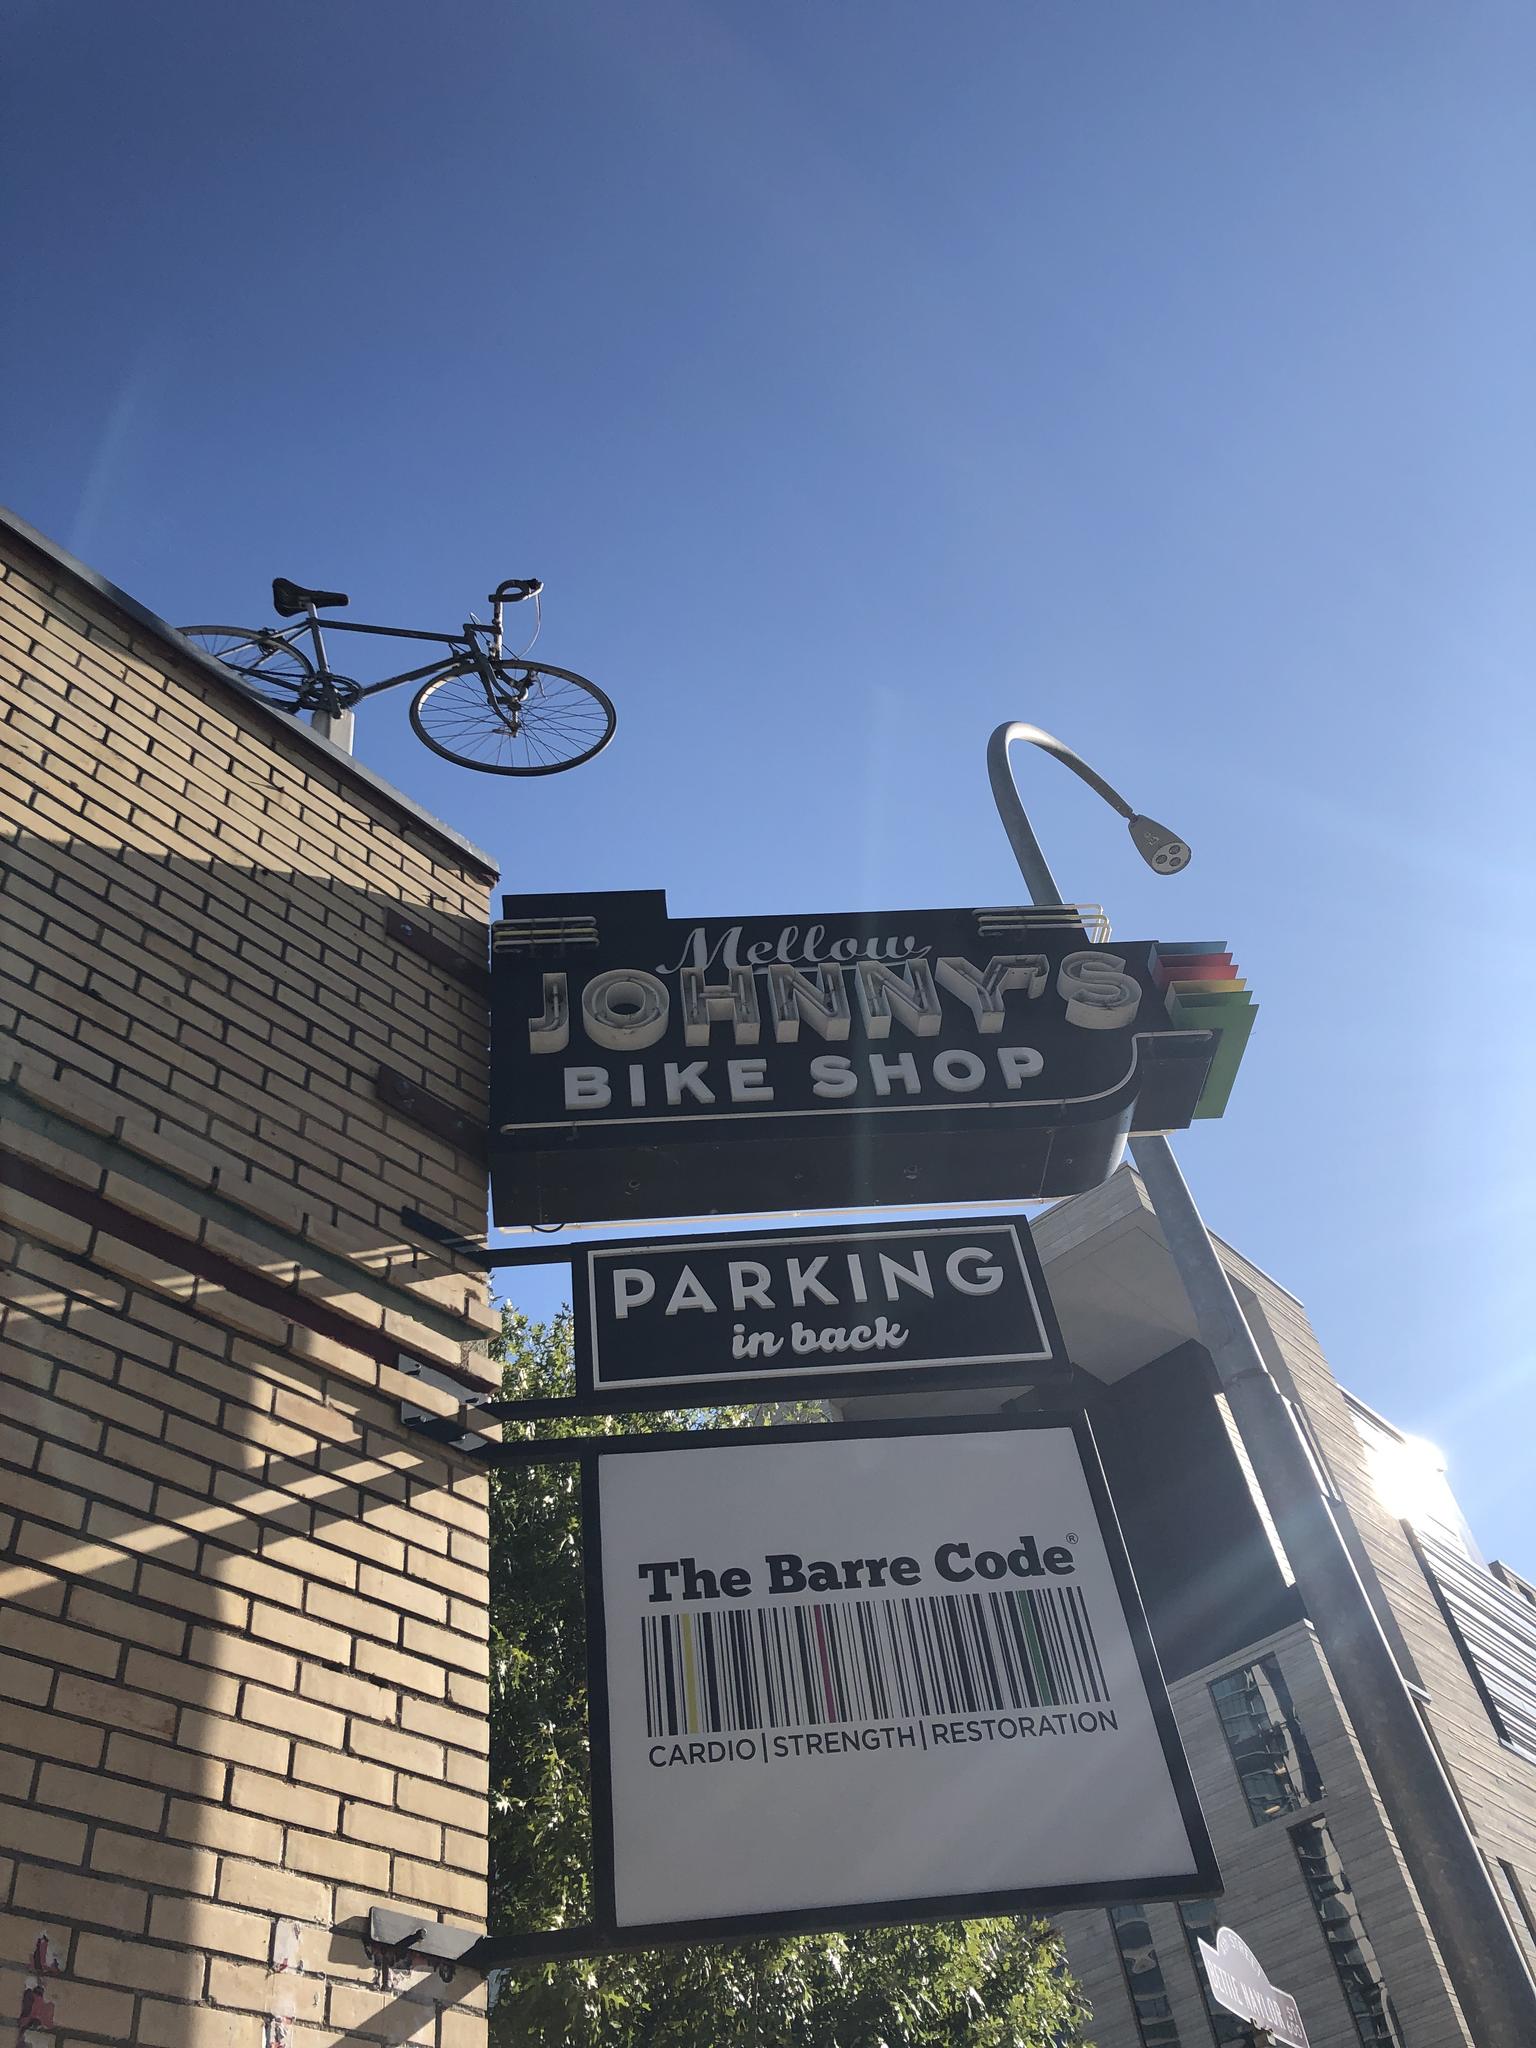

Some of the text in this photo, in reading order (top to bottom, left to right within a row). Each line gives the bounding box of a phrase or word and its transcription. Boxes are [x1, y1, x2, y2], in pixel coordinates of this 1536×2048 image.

[655, 925, 932, 974] Mellow
[529, 951, 1142, 1054] JOHNNY'S
[564, 1047, 1044, 1110] BIKE SHOP
[613, 1247, 1004, 1319] PARKING
[732, 1316, 910, 1359] in back
[638, 1558, 752, 1602] The
[765, 1554, 921, 1595] Barre
[649, 1710, 1118, 1767] CARDIO STRENGTH RESTORATION
